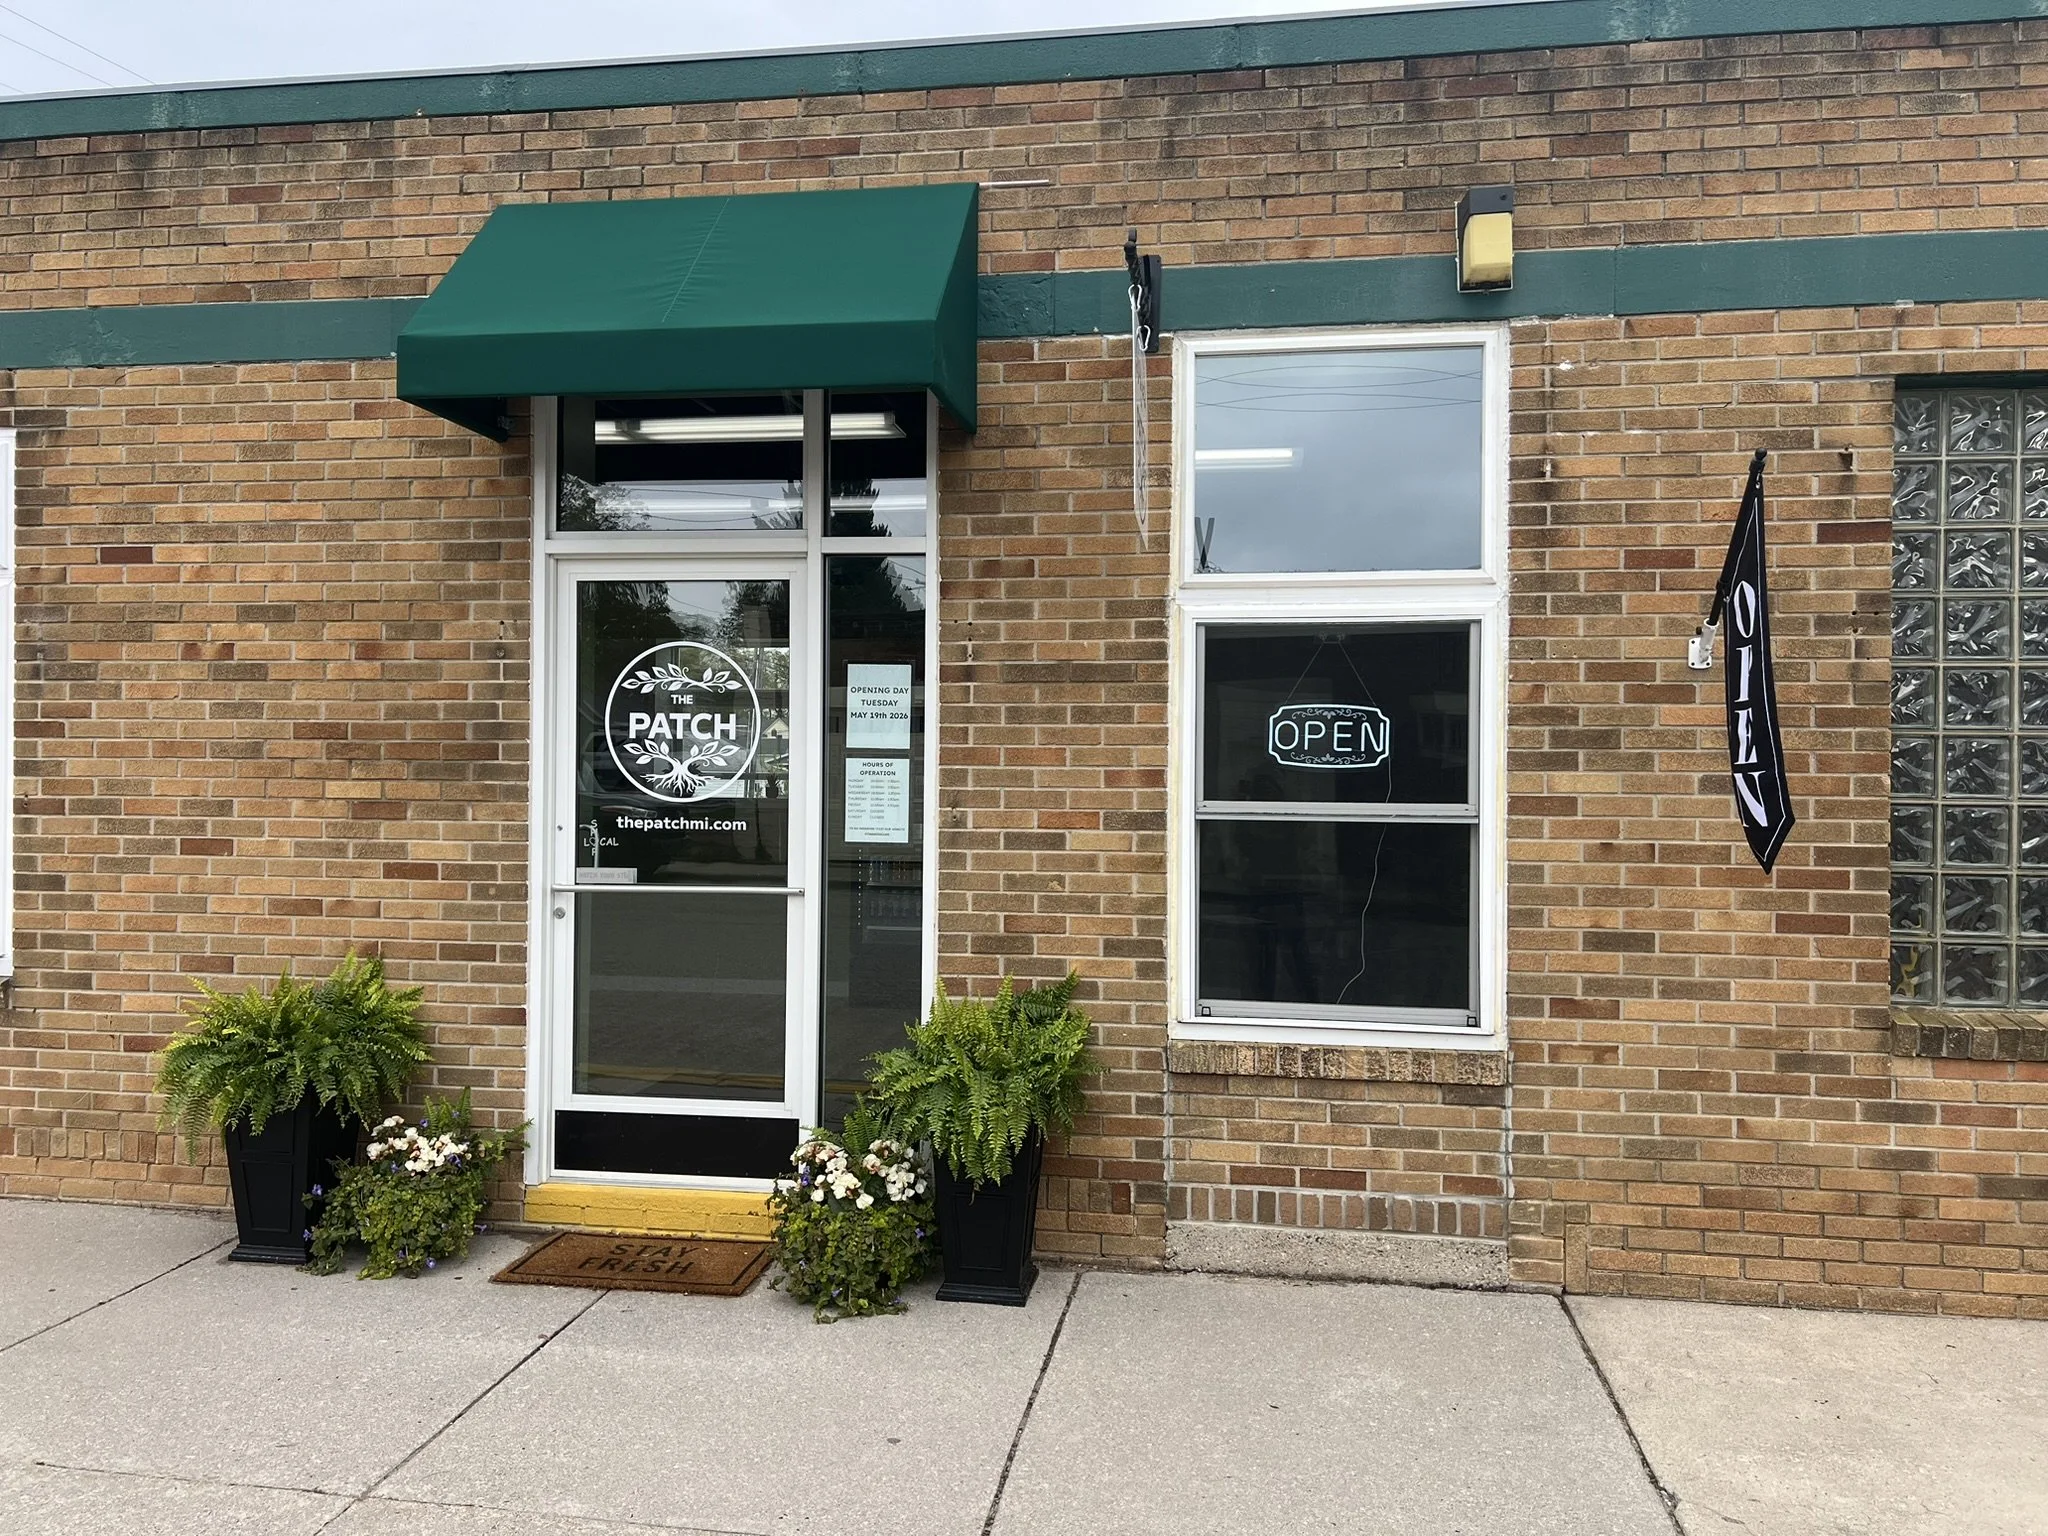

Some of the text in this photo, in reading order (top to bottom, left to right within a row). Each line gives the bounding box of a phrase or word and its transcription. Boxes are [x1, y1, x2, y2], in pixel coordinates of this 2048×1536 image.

[850, 686, 891, 694] OPENING
[670, 694, 693, 705] THE
[860, 699, 899, 707] TUESDAY
[850, 711, 909, 720] MAY 19th 2026
[628, 712, 737, 740] PATCH
[1274, 720, 1384, 752] OPEN
[616, 816, 747, 831] thepatchmi.com
[583, 837, 619, 847] LOCAL
[608, 1243, 701, 1258] STAY
[577, 1256, 696, 1275] FRESH
